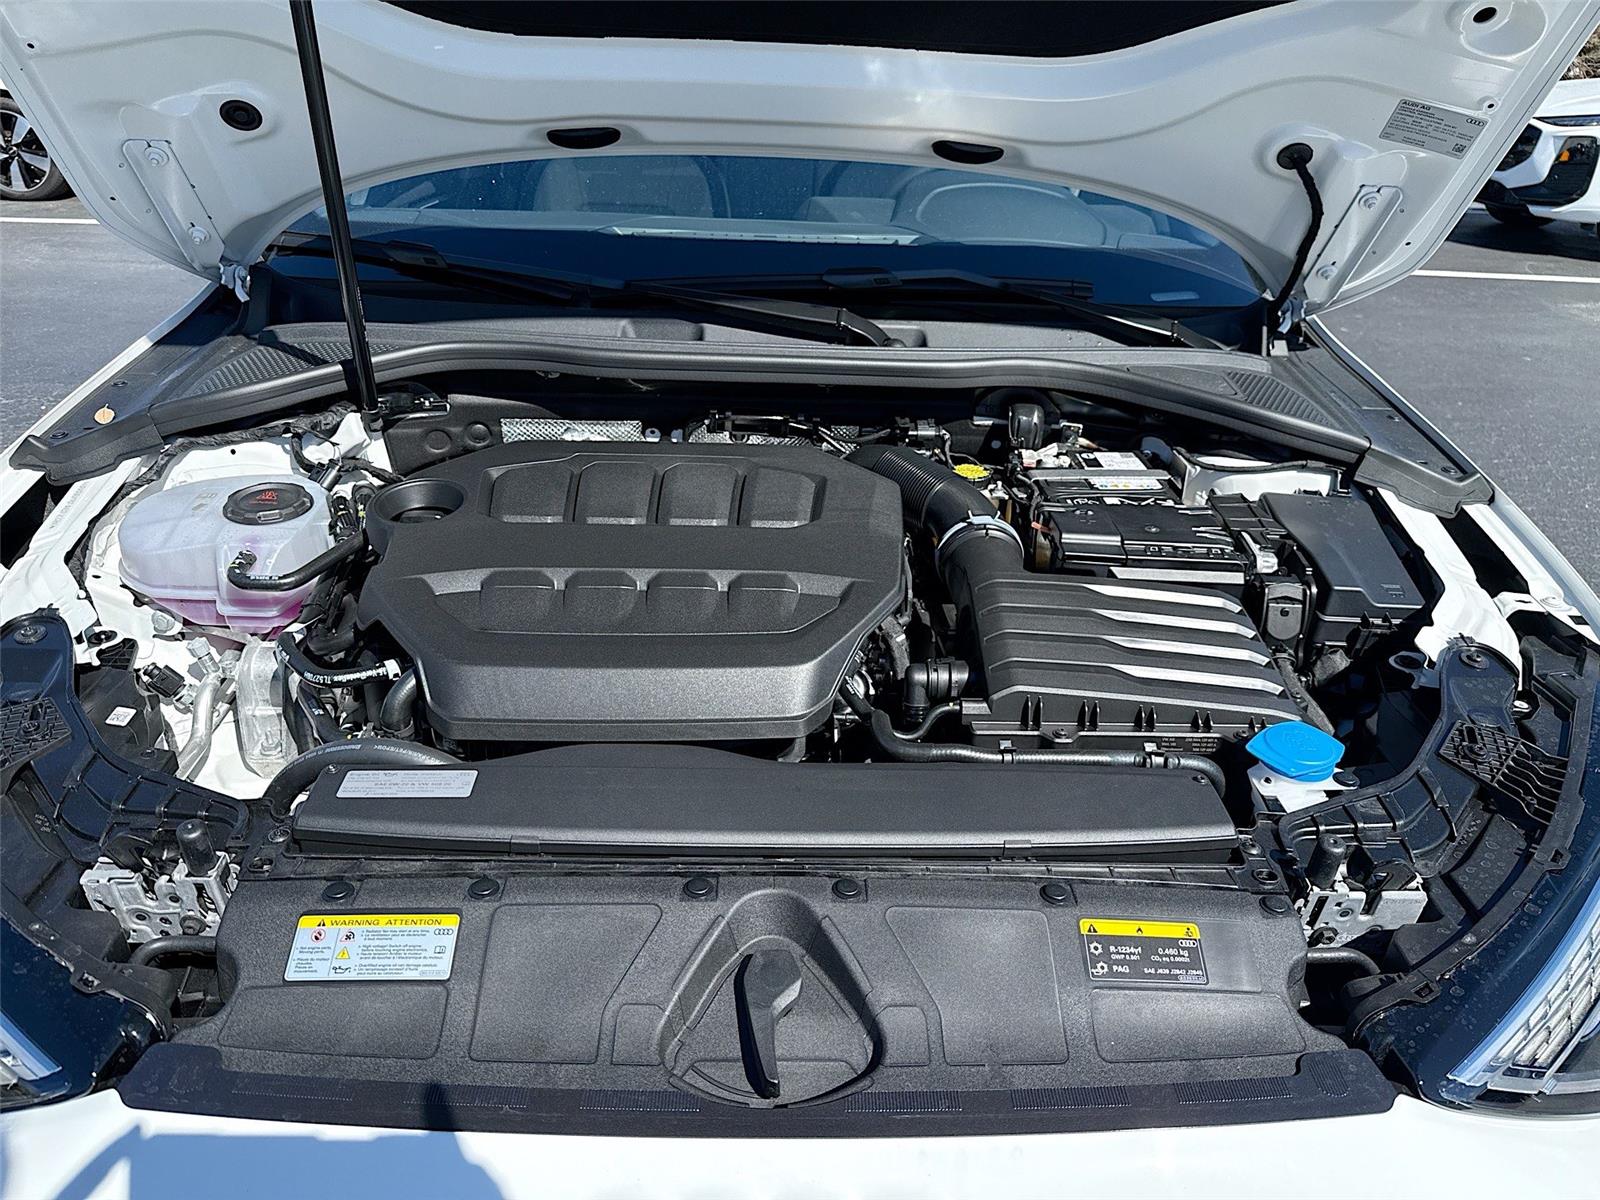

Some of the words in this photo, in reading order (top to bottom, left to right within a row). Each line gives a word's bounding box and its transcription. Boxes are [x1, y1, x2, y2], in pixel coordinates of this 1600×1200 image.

[1109, 945, 1142, 955] R-1234yf
[1179, 948, 1189, 957] kg
[1112, 964, 1130, 974] PAG
